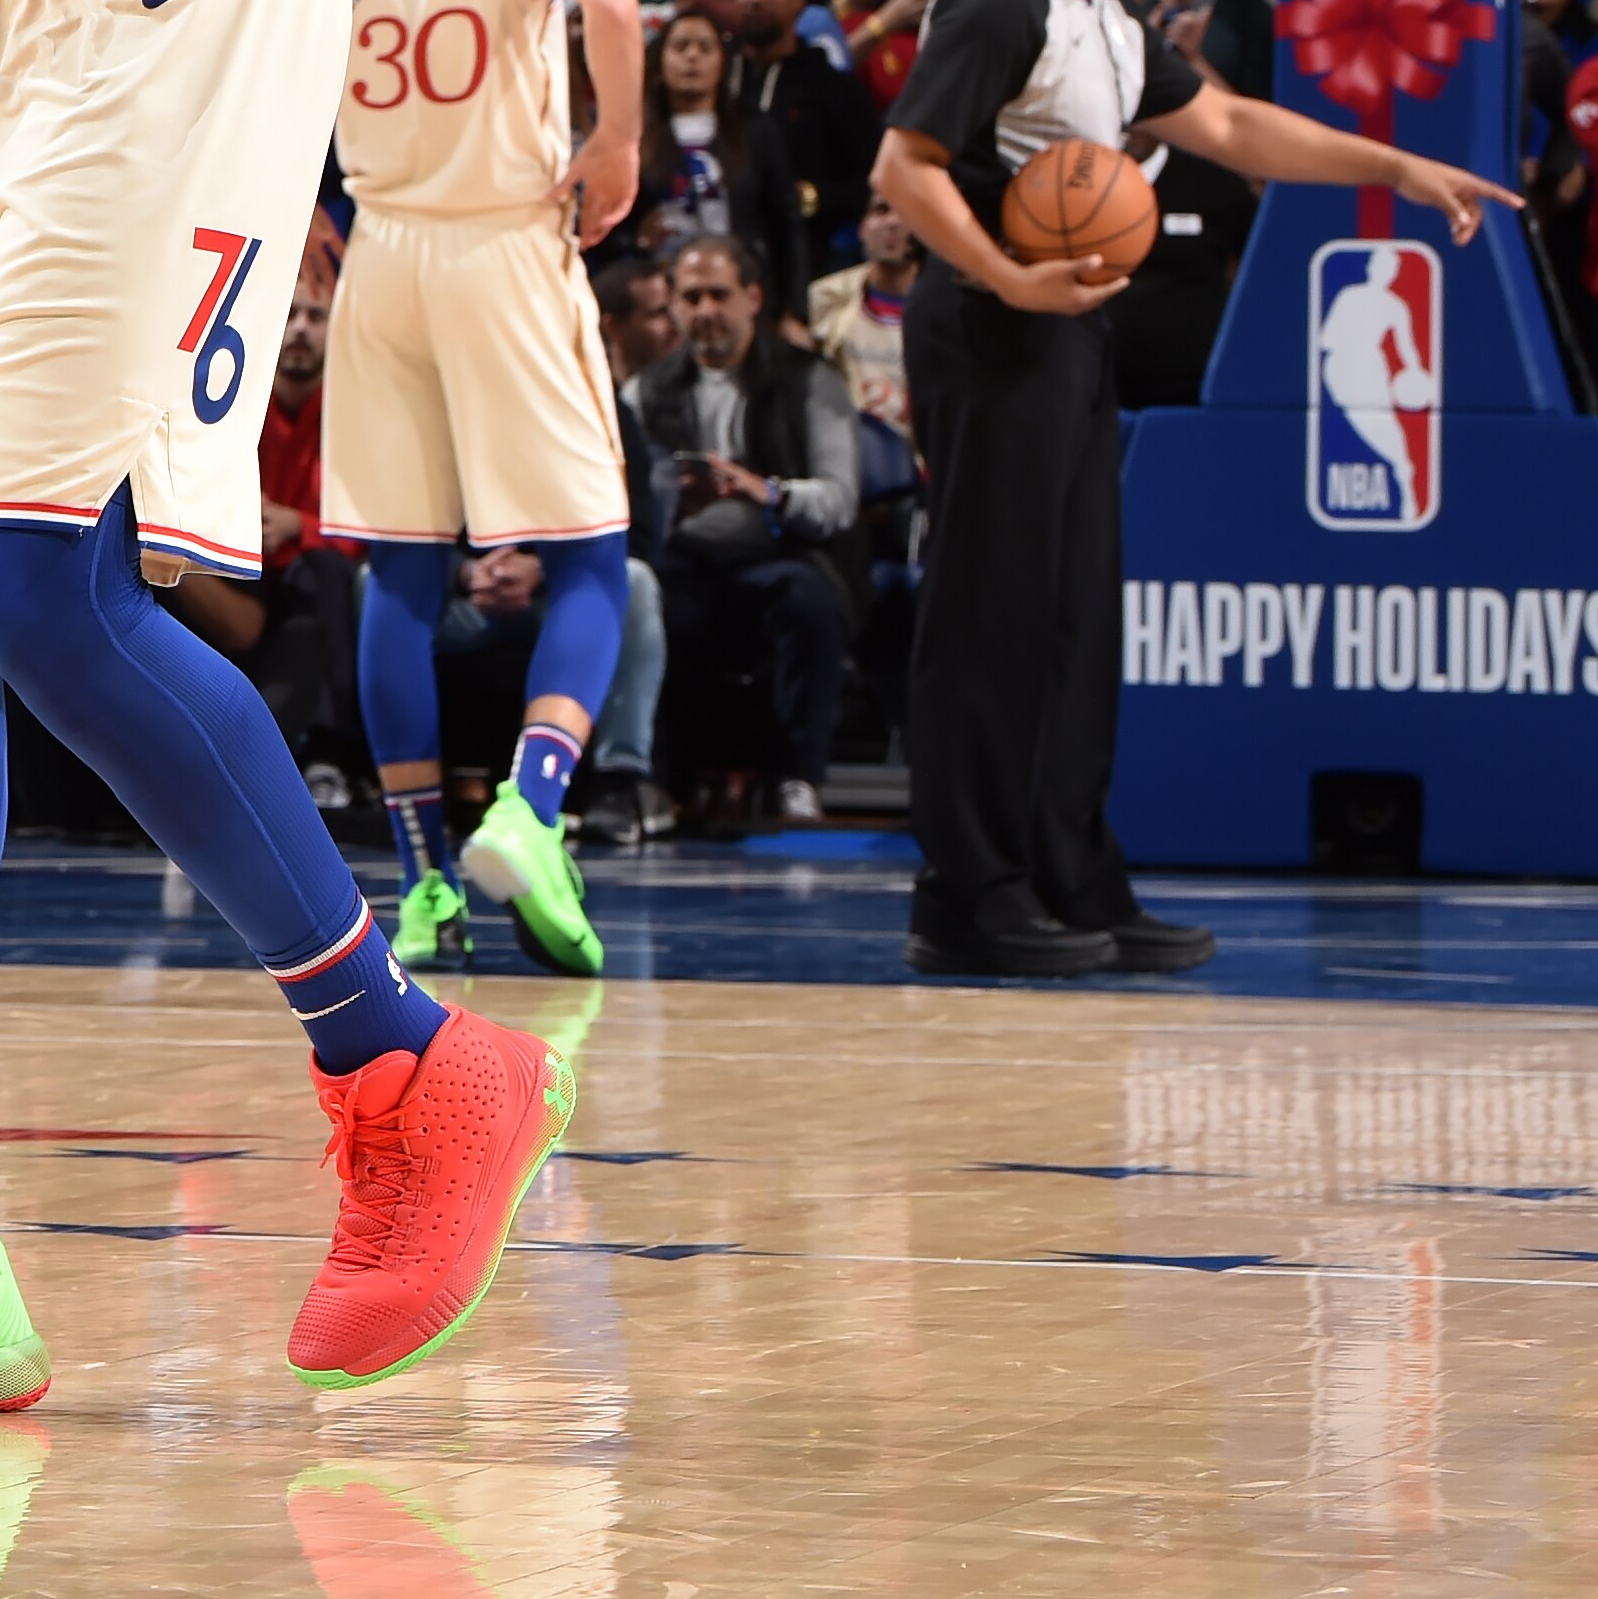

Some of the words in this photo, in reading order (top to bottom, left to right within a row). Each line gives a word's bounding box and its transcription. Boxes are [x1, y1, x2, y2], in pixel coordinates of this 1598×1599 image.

[352, 6, 489, 110] 30
[177, 226, 262, 425] 76
[1327, 462, 1391, 510] NBA
[1122, 580, 1324, 689] HAPPY
